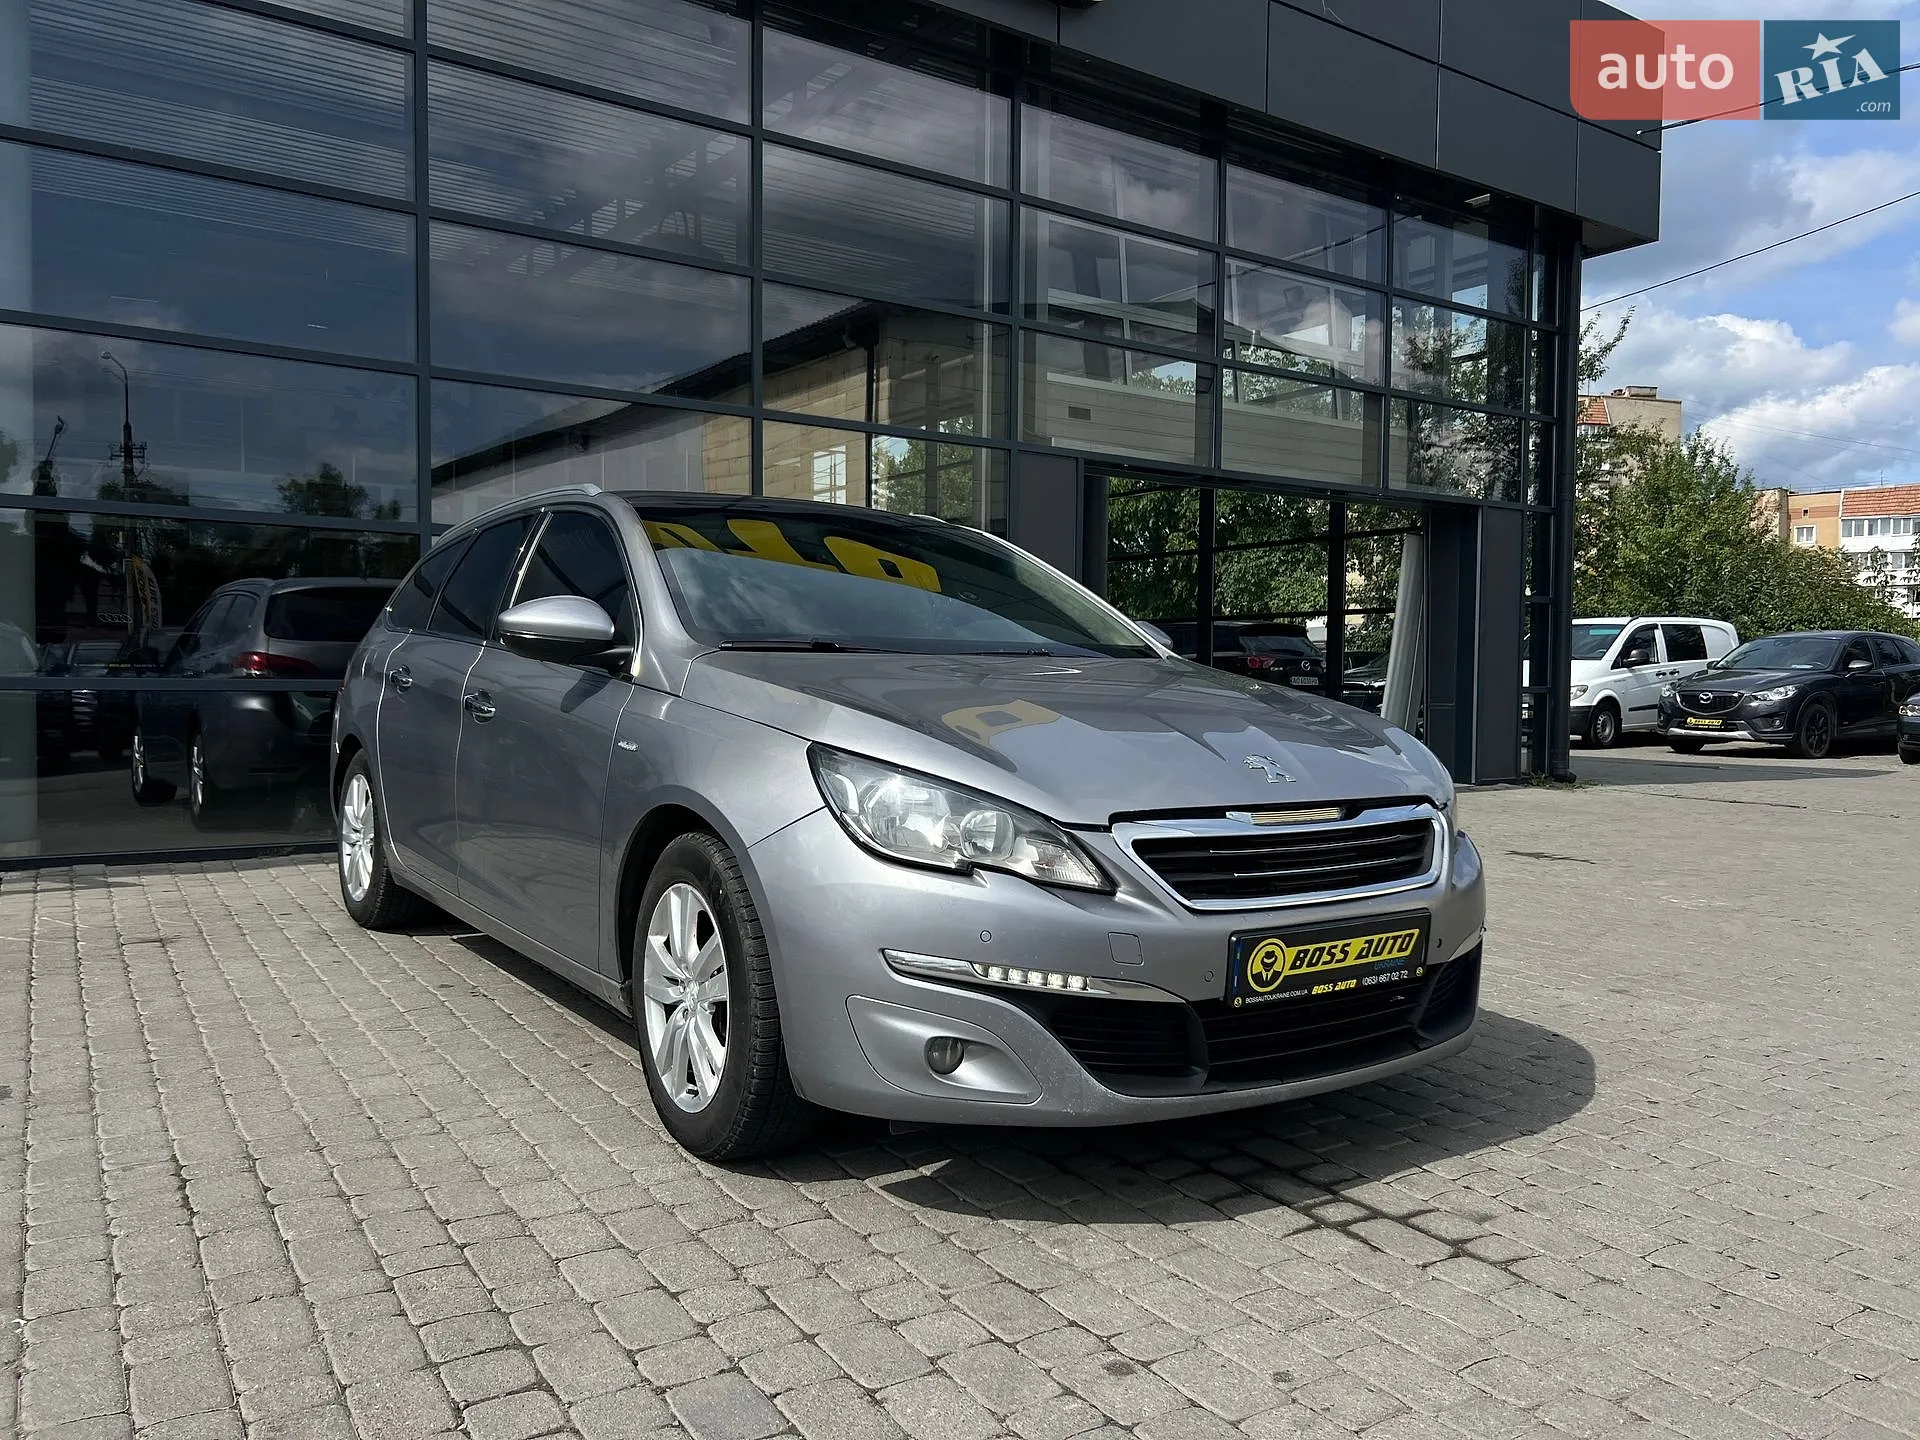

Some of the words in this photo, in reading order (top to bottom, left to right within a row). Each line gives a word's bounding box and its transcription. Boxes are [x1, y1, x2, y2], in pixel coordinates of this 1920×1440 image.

[1289, 944, 1352, 970] BOSS
[1353, 933, 1415, 961] AUTO
[1311, 983, 1334, 995] BOSS
[1334, 979, 1357, 992] AUTO
